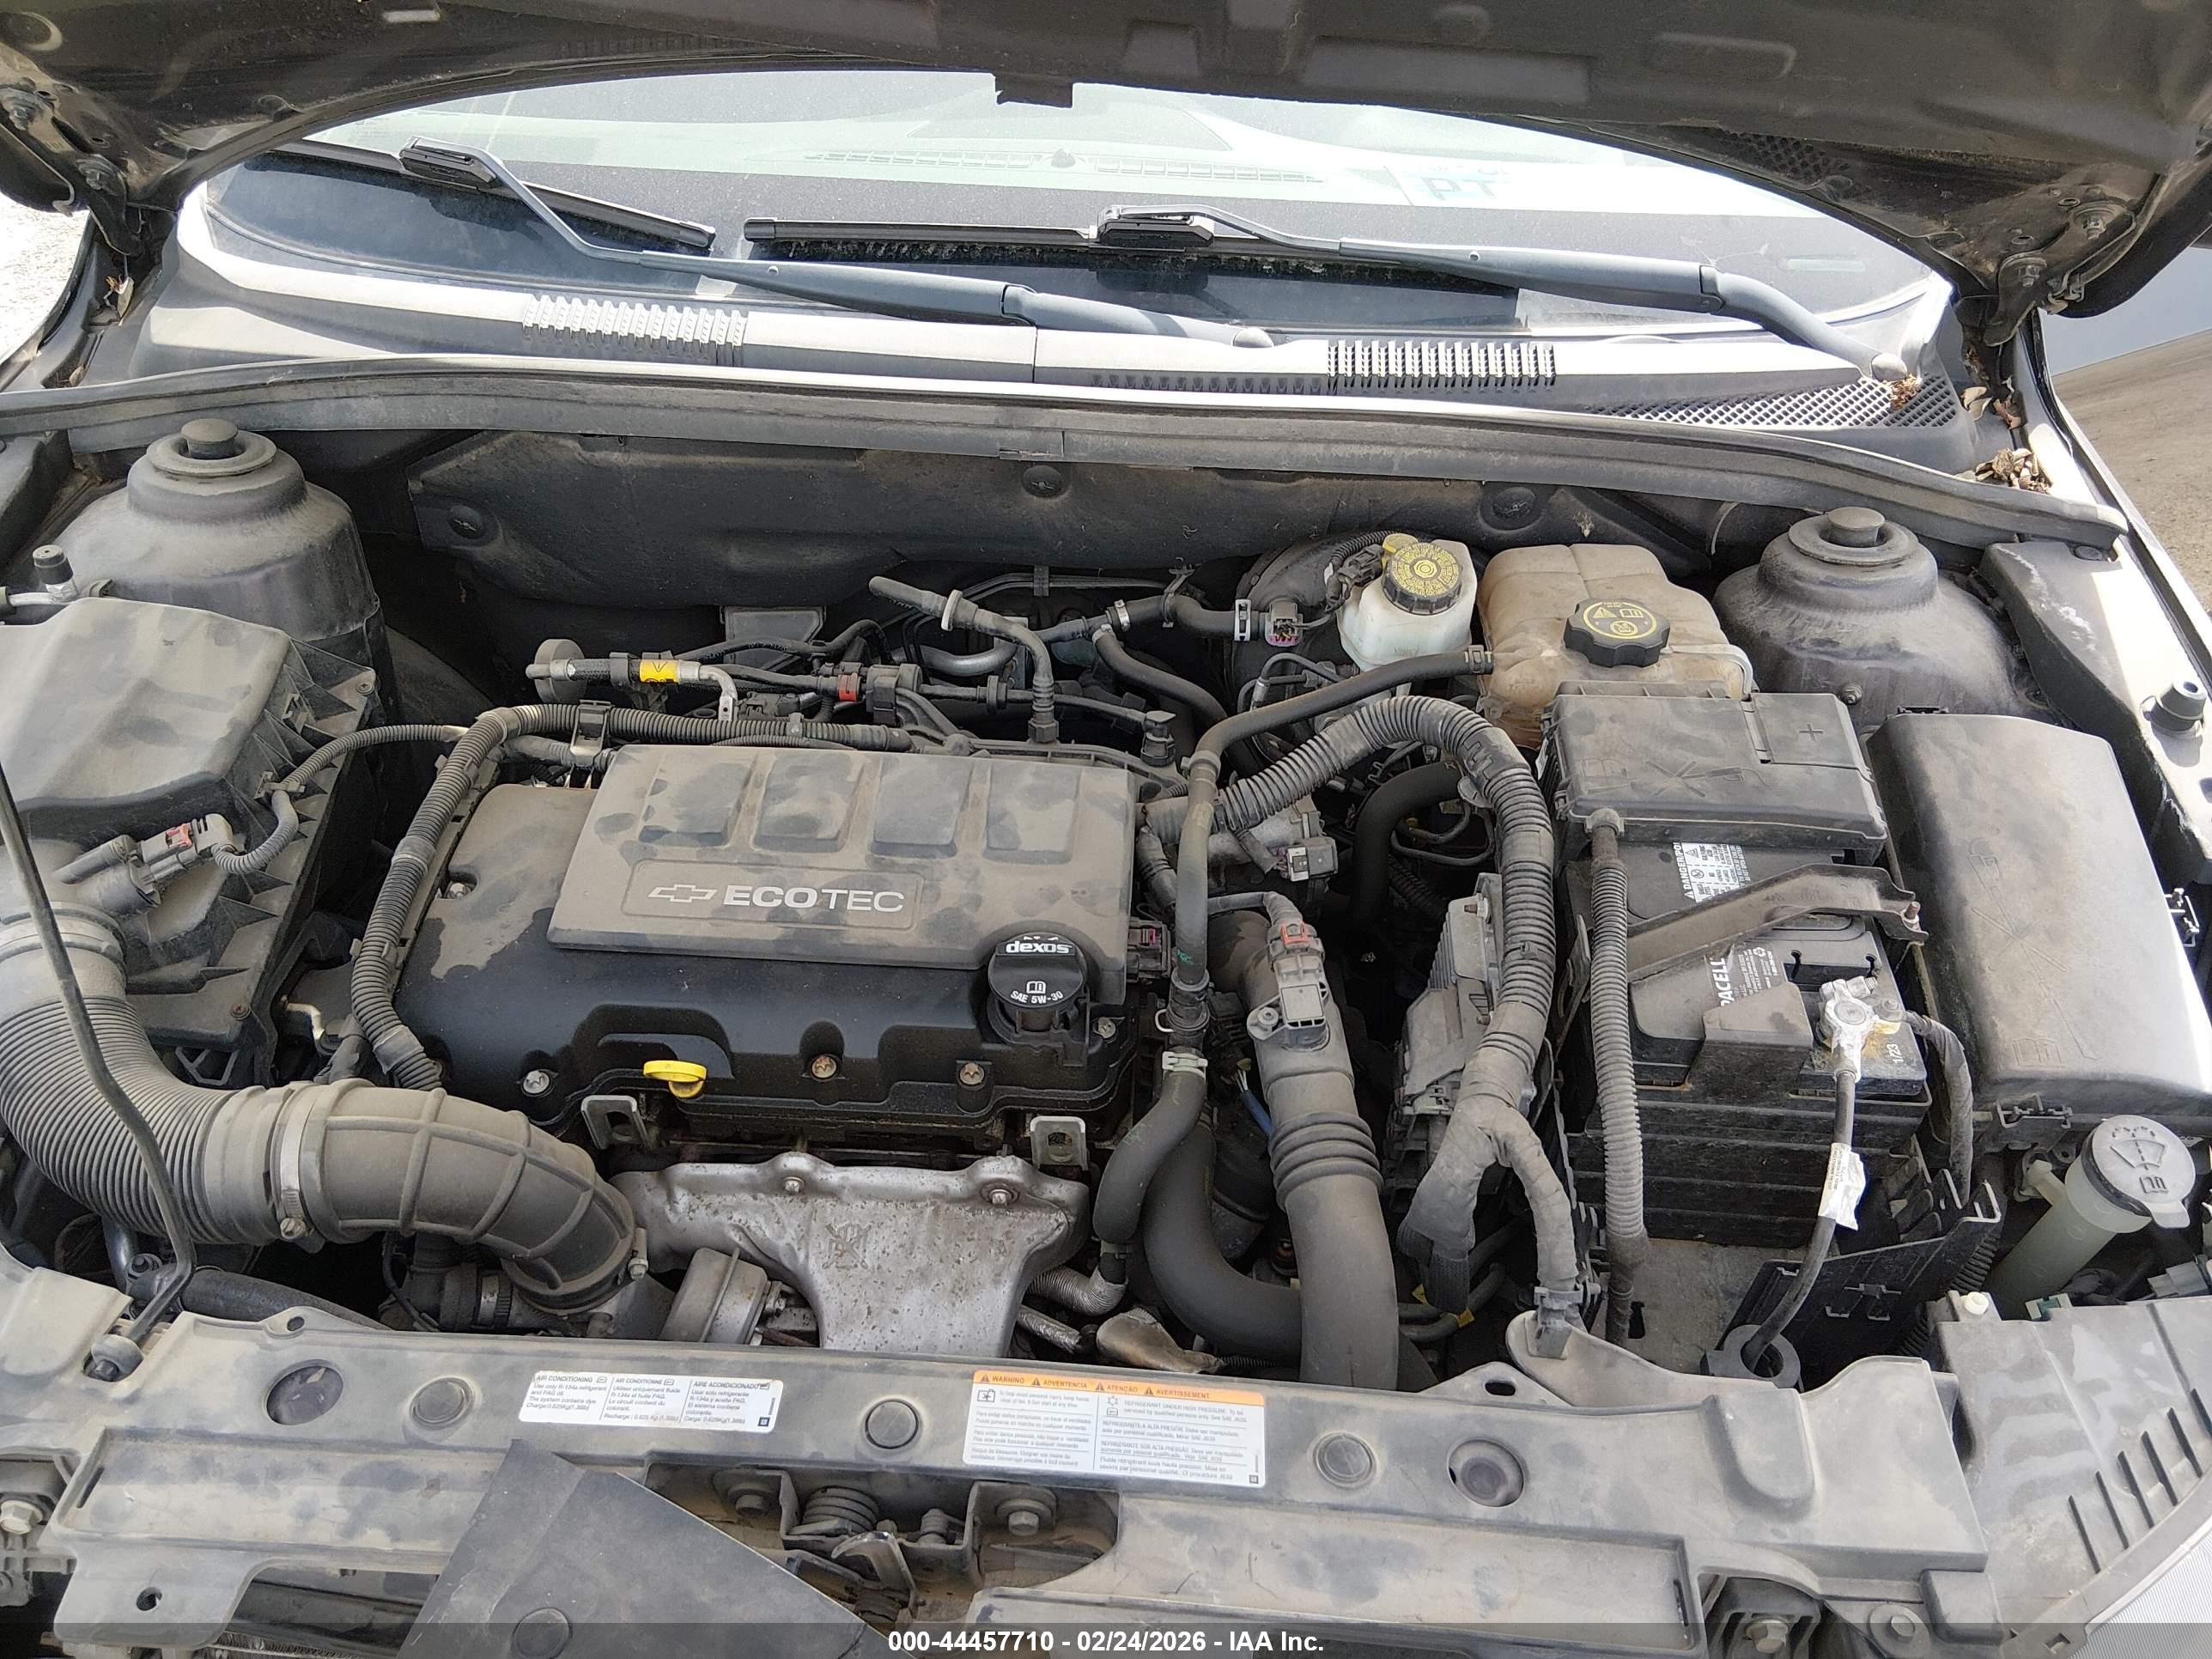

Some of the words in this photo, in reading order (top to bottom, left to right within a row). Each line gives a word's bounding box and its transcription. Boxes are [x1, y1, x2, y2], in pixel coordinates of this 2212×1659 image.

[723, 884, 905, 913] ECOTEC
[1006, 940, 1073, 954] dexos
[1010, 990, 1029, 1003] SAE
[1030, 990, 1064, 1004] 5W-30
[992, 1375, 1024, 1384] WARNING
[1042, 1380, 1088, 1389] ADVERTENCIA
[1156, 1389, 1211, 1399] AVERTISSEMENT
